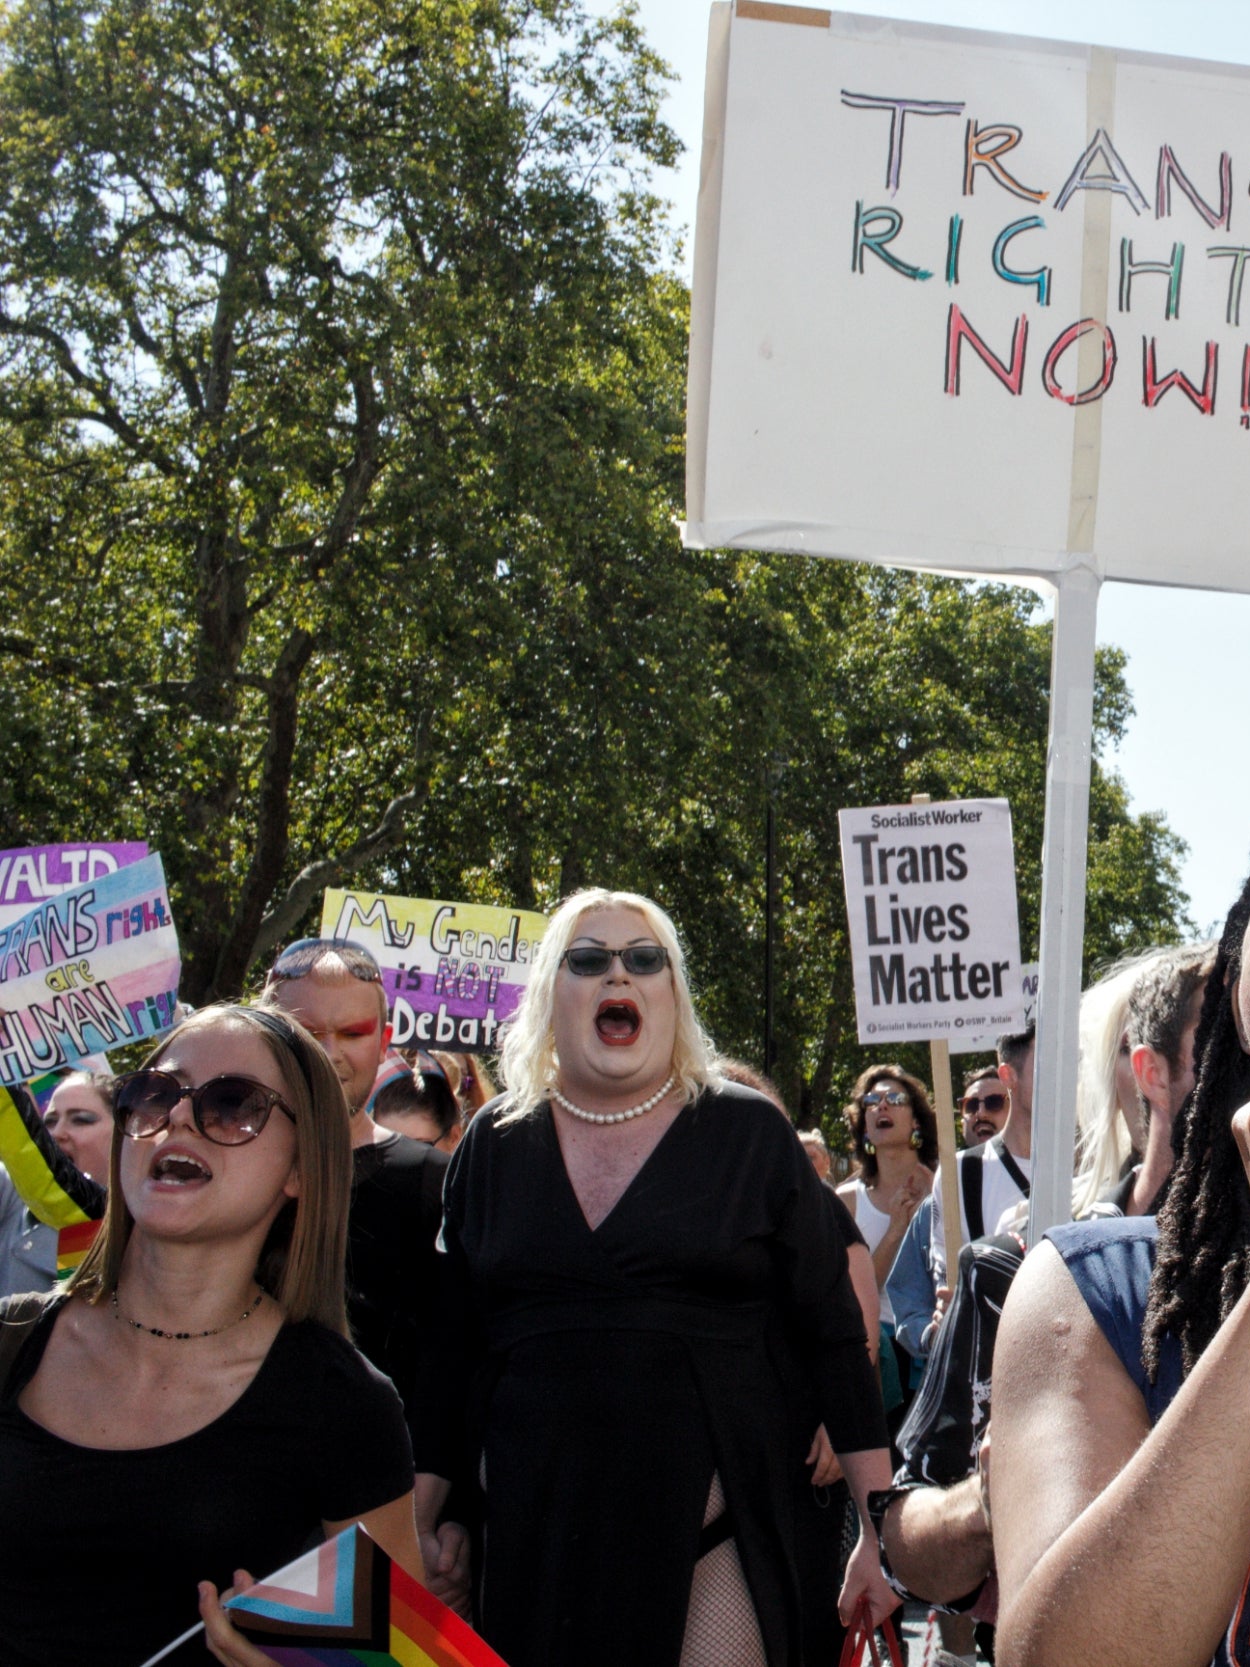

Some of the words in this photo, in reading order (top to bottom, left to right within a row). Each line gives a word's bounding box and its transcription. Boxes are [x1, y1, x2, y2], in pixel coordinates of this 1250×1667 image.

[852, 833, 968, 887] Trans
[0, 888, 99, 983] RANS
[106, 897, 172, 945] rights
[334, 895, 415, 949] My
[864, 892, 970, 947] Lives
[45, 958, 95, 993] are
[394, 962, 422, 991] is
[434, 956, 506, 1004] NOT
[868, 952, 1010, 1007] Matter
[0, 980, 133, 1085] HUMAN
